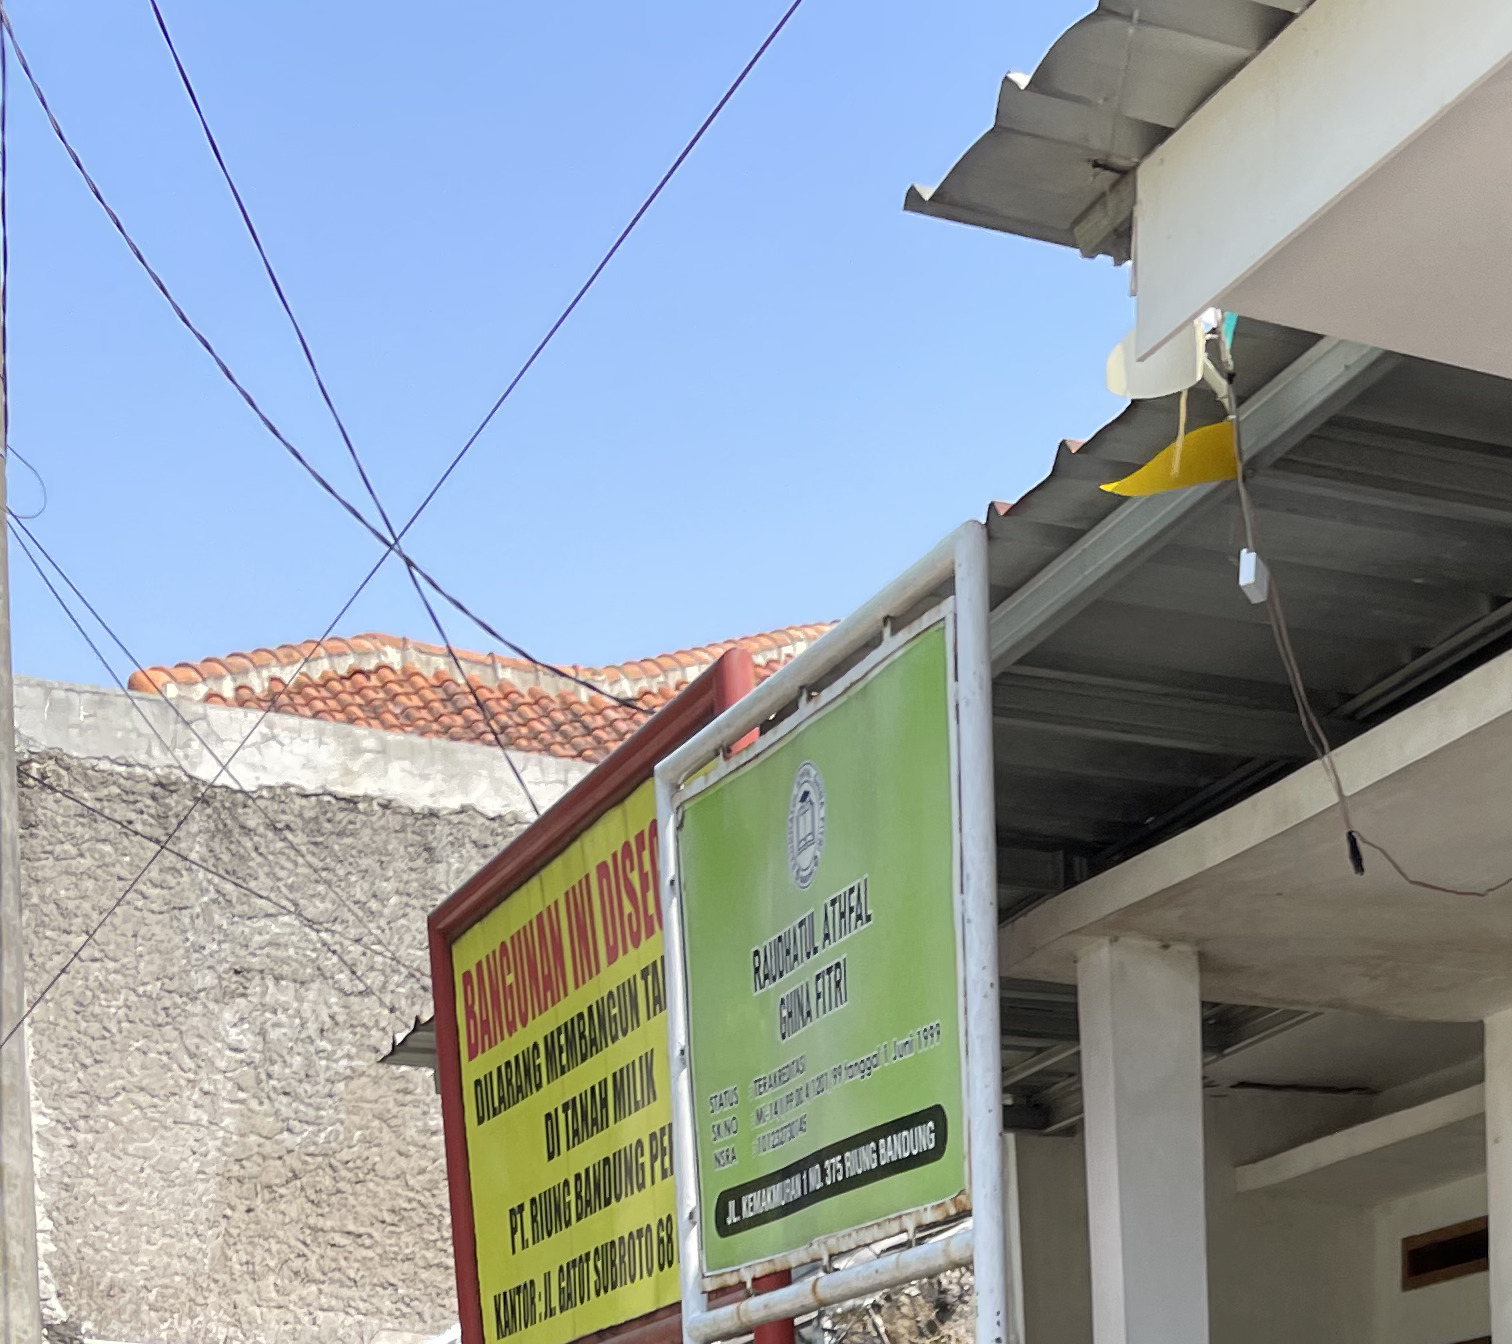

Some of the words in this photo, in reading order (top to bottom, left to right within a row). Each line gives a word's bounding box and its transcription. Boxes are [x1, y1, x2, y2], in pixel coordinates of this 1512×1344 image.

[462, 899, 568, 1062] BANGUNAN
[564, 872, 602, 990] INI
[752, 910, 819, 993] RAUDHATUL
[822, 876, 872, 951] ATHFAL
[474, 1041, 543, 1126] DILARANG
[543, 974, 641, 1086] MEMBANGUN
[780, 980, 812, 1040] GHINA
[815, 956, 848, 1019] FITRI
[544, 1106, 561, 1162] DI
[562, 1077, 609, 1151] TANAH
[612, 1048, 657, 1125] MILIK
[824, 1154, 844, 1185] 375
[845, 1141, 878, 1178] RIUNG
[879, 1120, 936, 1165] BANDUNG
[509, 1201, 528, 1255] PT.
[530, 1178, 571, 1247] RIUNG
[575, 1138, 645, 1223] BANDUNG
[494, 1279, 537, 1341] KANTOR
[558, 1251, 592, 1313] GATOT
[592, 1223, 654, 1298] SUBROTO
[657, 1213, 674, 1272] 68
